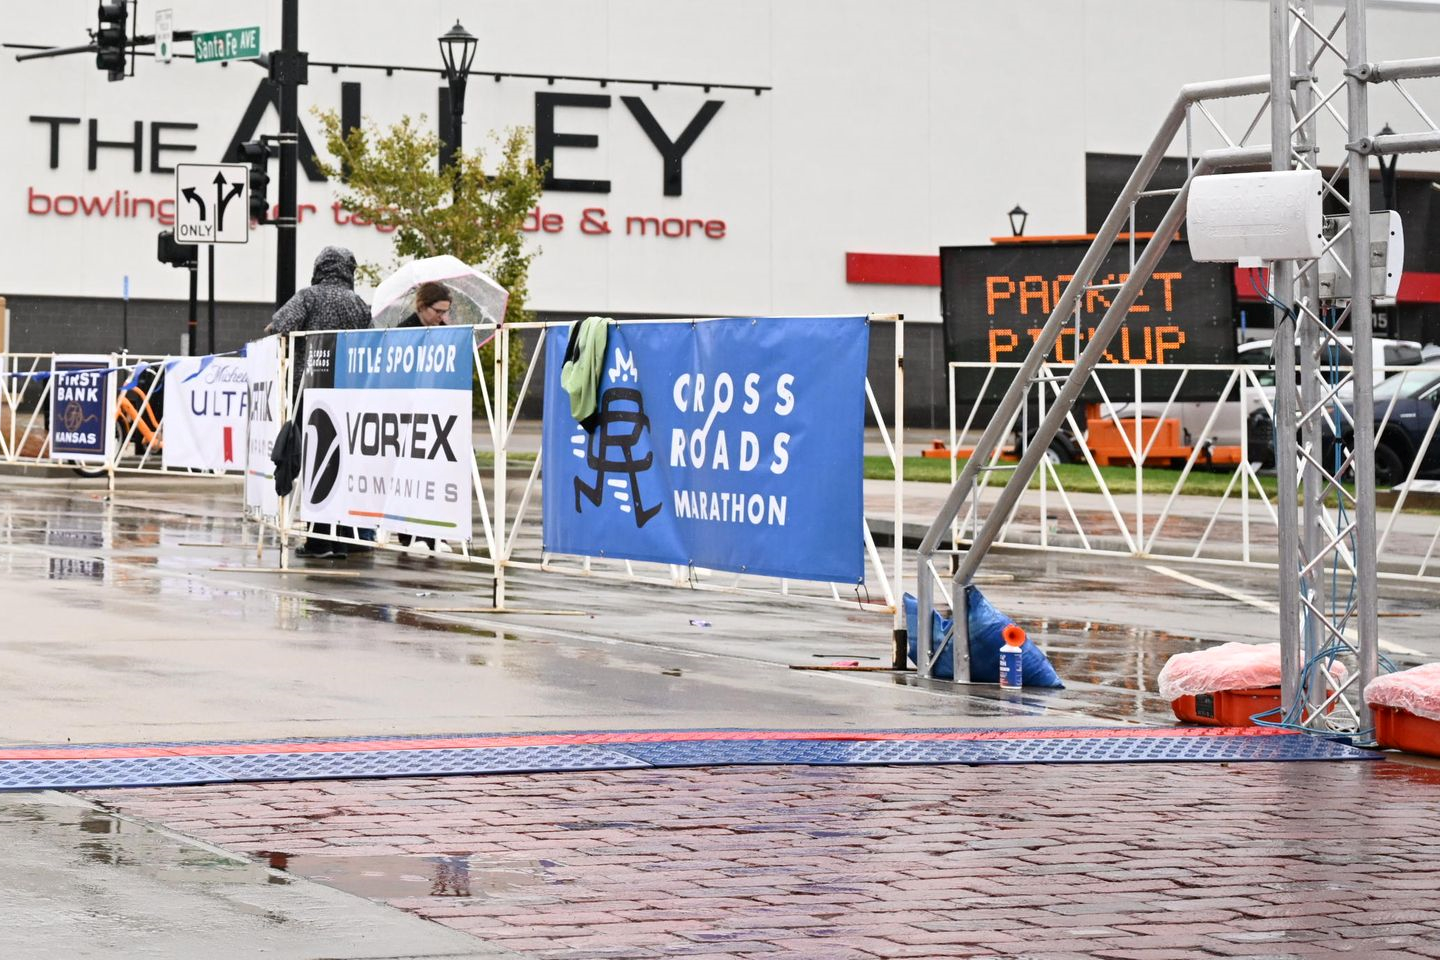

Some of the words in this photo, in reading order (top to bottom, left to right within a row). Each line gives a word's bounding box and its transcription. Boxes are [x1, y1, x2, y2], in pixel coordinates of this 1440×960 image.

[196, 36, 225, 59] Santa
[225, 32, 238, 56] Fe
[239, 29, 257, 49] AVE
[29, 115, 198, 174] THE
[180, 224, 213, 237] ONLY
[580, 207, 612, 235] &
[625, 215, 727, 240] more
[348, 347, 383, 373] TITLE
[386, 344, 457, 373] SPONSOR
[988, 326, 1186, 364] PCUP
[57, 388, 99, 402] BANK
[673, 372, 795, 416] CROSS
[55, 431, 97, 444] KANSAS
[346, 411, 458, 462] VORTEX
[670, 428, 791, 475] ROADS
[673, 490, 788, 526] MARATHON
